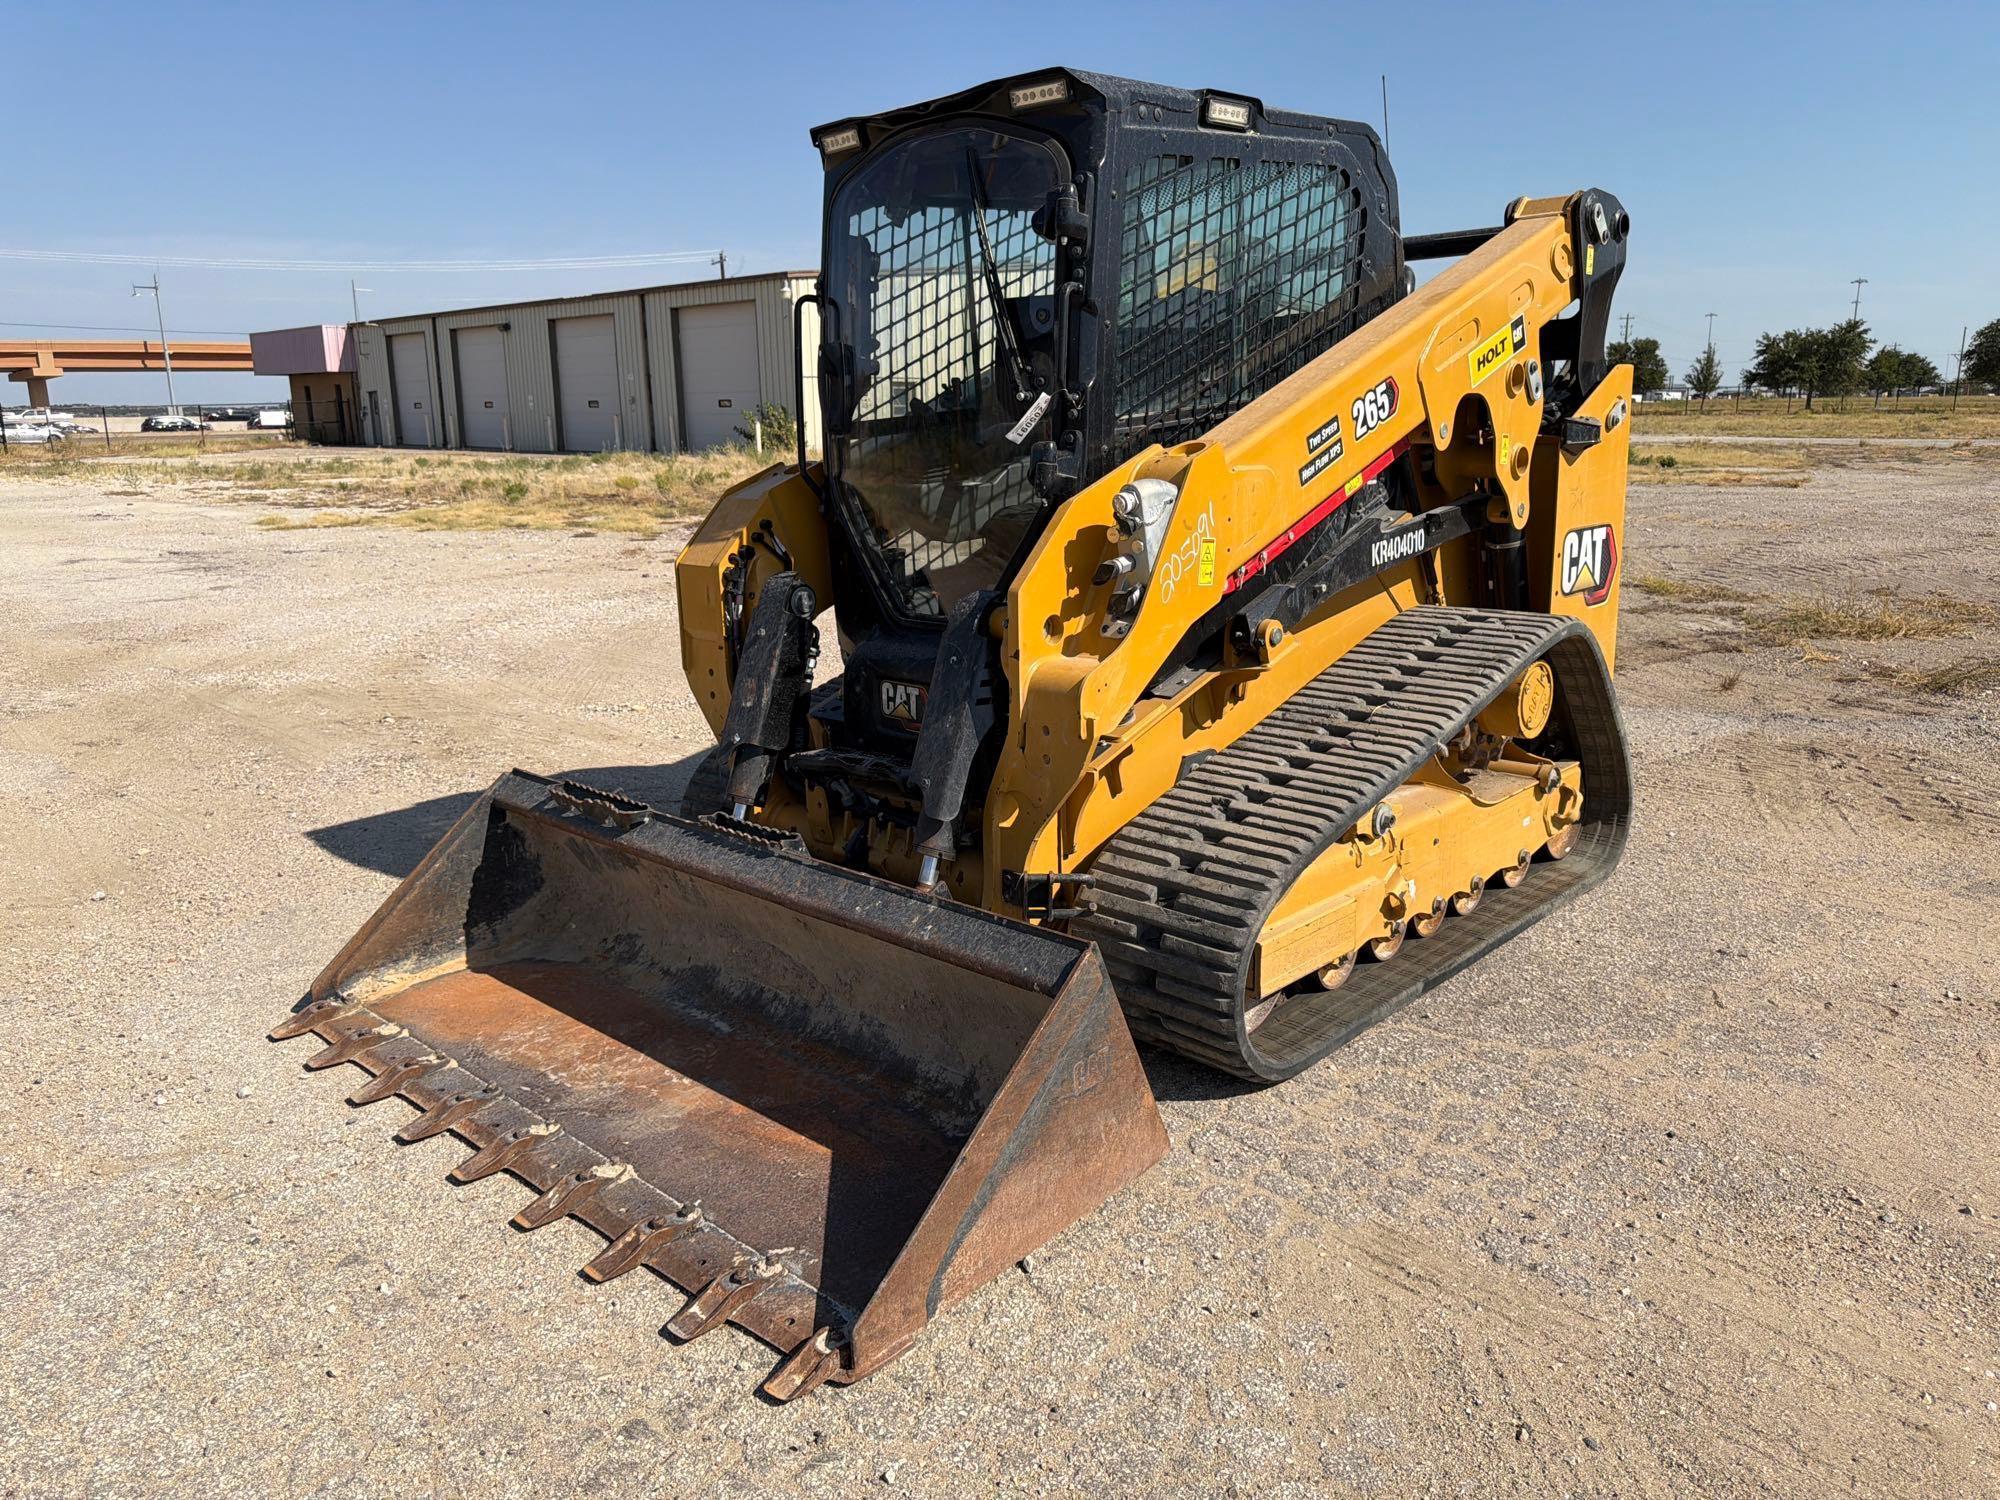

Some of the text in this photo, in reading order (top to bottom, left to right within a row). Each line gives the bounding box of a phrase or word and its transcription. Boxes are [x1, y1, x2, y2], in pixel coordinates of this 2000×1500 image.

[1477, 324, 1523, 372] HOLT CAT
[1352, 381, 1390, 439] 265
[1329, 442, 1341, 460] XPS
[1371, 528, 1425, 567] KR404010
[1561, 526, 1607, 594] CAT
[881, 681, 920, 721] CAT
